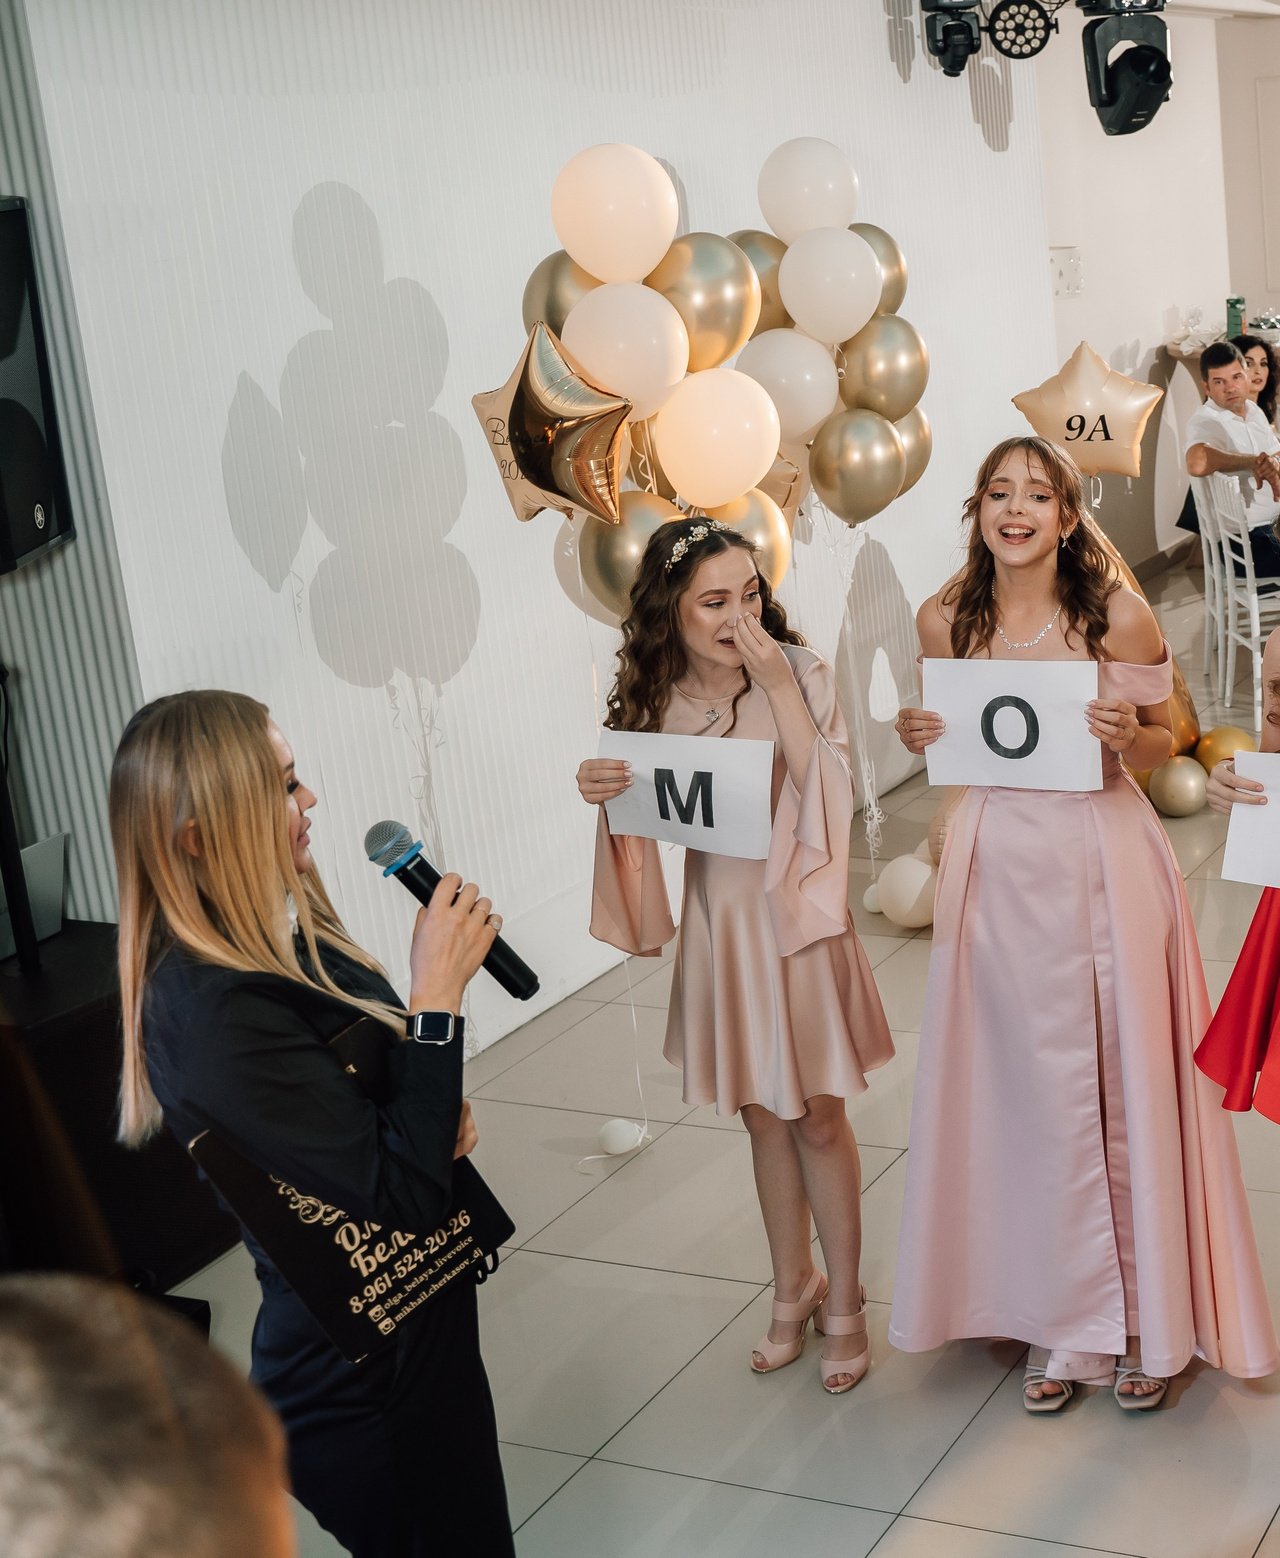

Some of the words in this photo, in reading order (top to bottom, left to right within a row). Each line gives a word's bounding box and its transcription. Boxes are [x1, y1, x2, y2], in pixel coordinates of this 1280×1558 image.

[348, 1209, 471, 1314] 8-961-524-20-26
[383, 1235, 474, 1310] olga_belaya_livevoice
[393, 1247, 484, 1323] mikhail.cherkasov_dj
